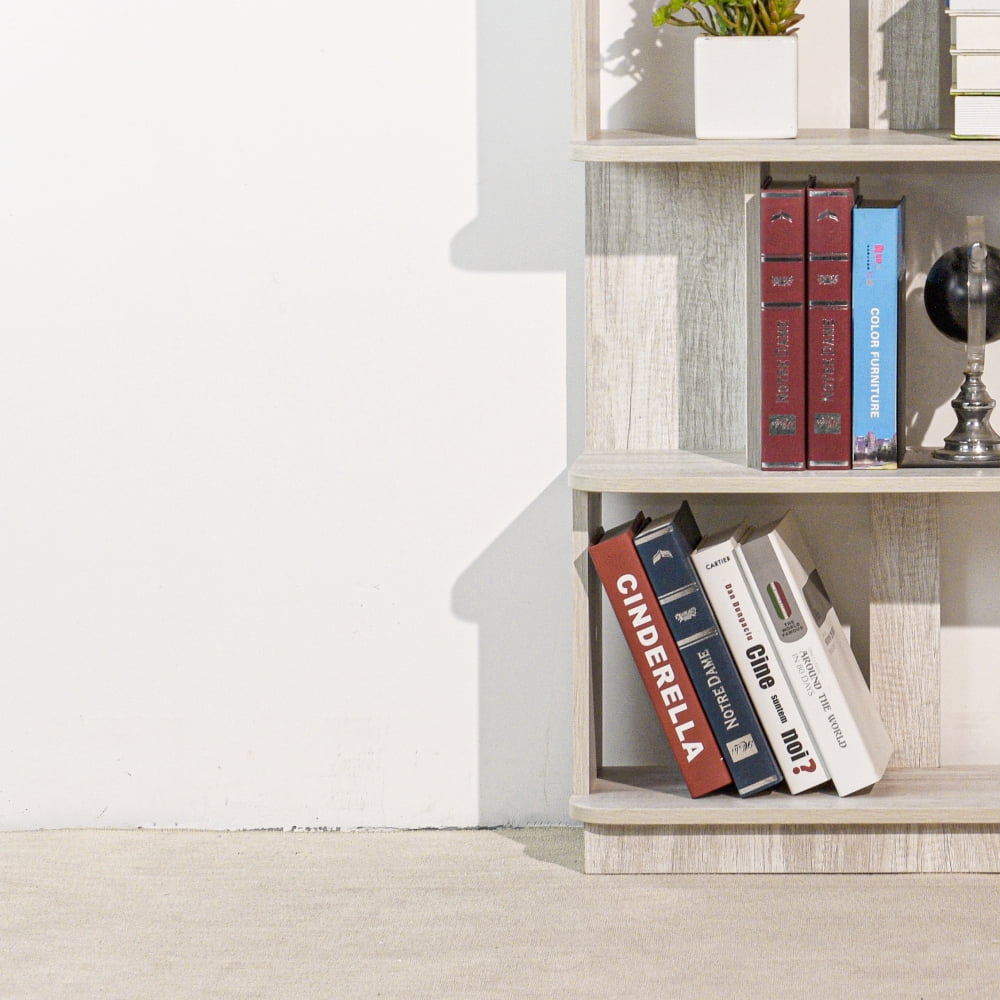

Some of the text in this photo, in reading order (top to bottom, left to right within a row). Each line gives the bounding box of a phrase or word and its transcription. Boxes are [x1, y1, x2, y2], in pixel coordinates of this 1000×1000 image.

[870, 307, 880, 419] COLOR FURNITURE
[705, 555, 731, 570] CARTIER
[725, 583, 736, 600] Dan
[616, 573, 704, 763] CINDERELLA
[697, 649, 740, 731] NOTRE DAME
[745, 643, 817, 775] Cine suntem noi?
[800, 650, 822, 690] AROUND
[818, 692, 832, 712] THE
[827, 714, 847, 749] WORLD
